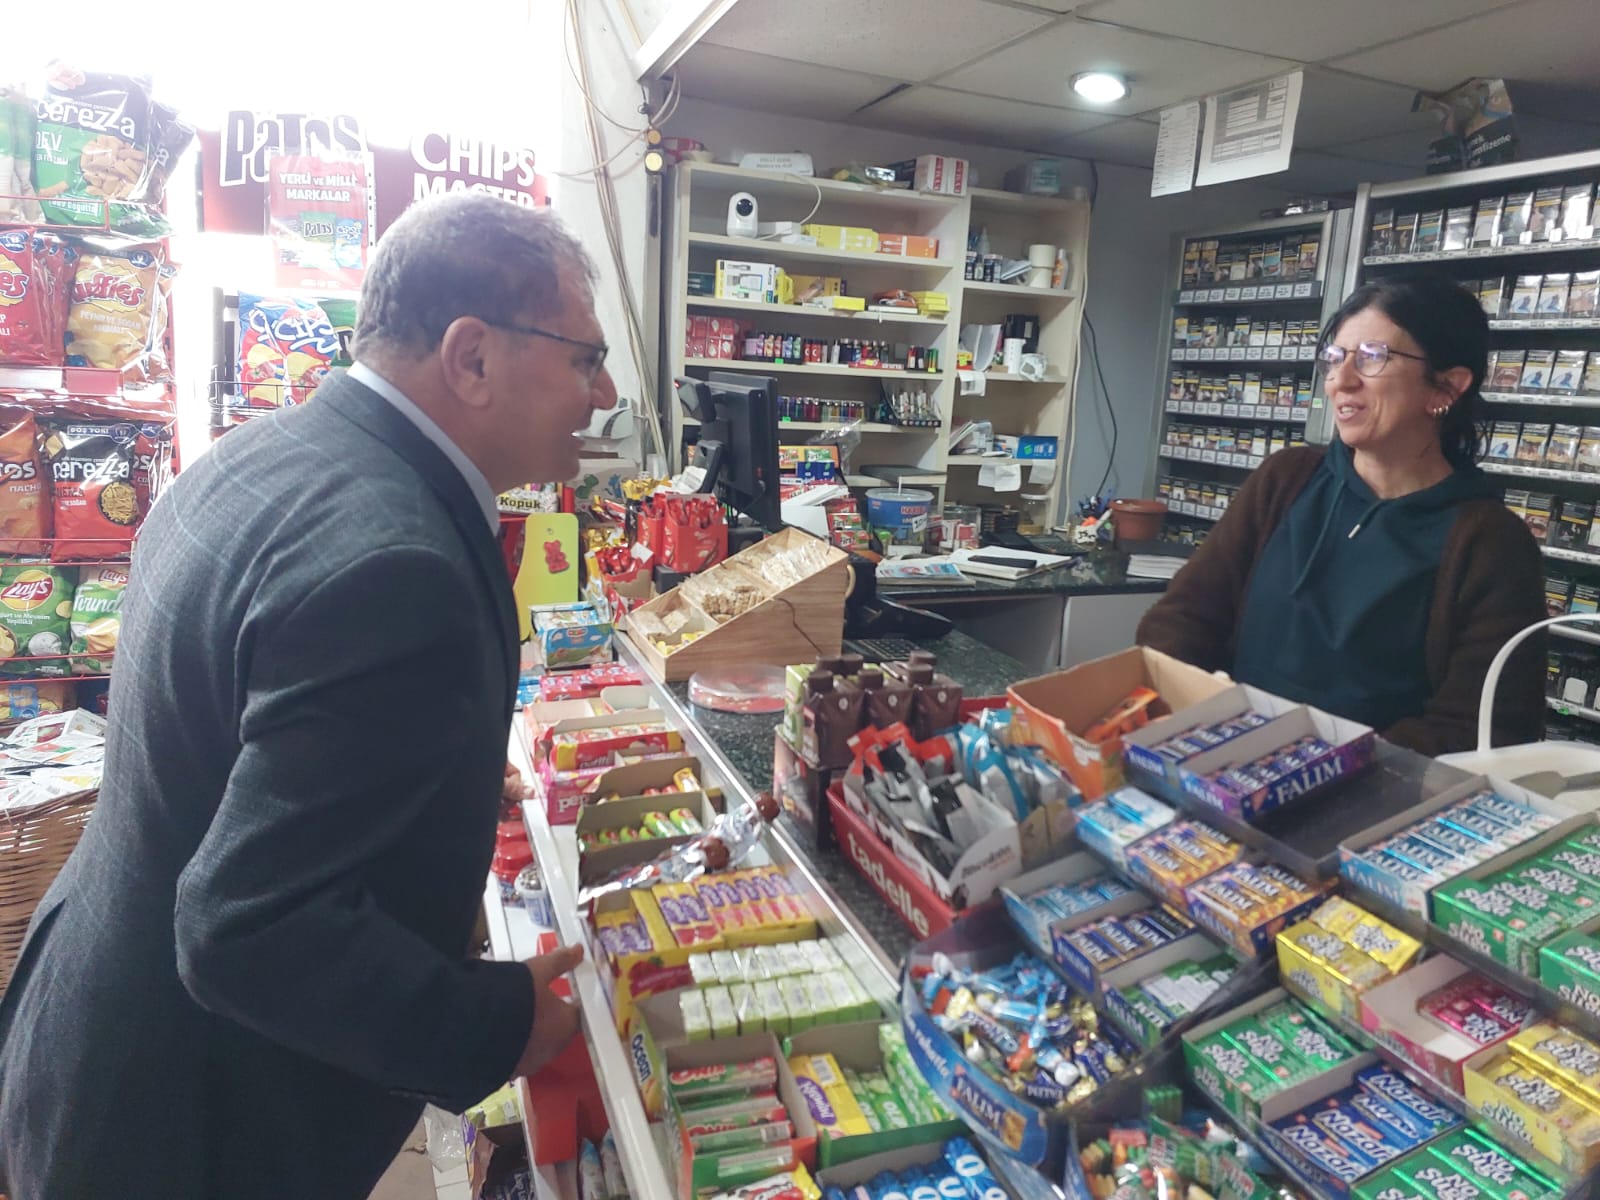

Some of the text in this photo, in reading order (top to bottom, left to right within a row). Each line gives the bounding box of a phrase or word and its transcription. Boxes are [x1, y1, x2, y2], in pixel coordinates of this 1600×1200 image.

[410, 131, 536, 187] CHIPS
[286, 188, 351, 202] MARKALAR
[3, 578, 50, 600] Lay's
[848, 833, 929, 937] tadelle
[631, 1033, 652, 1083] ocean
